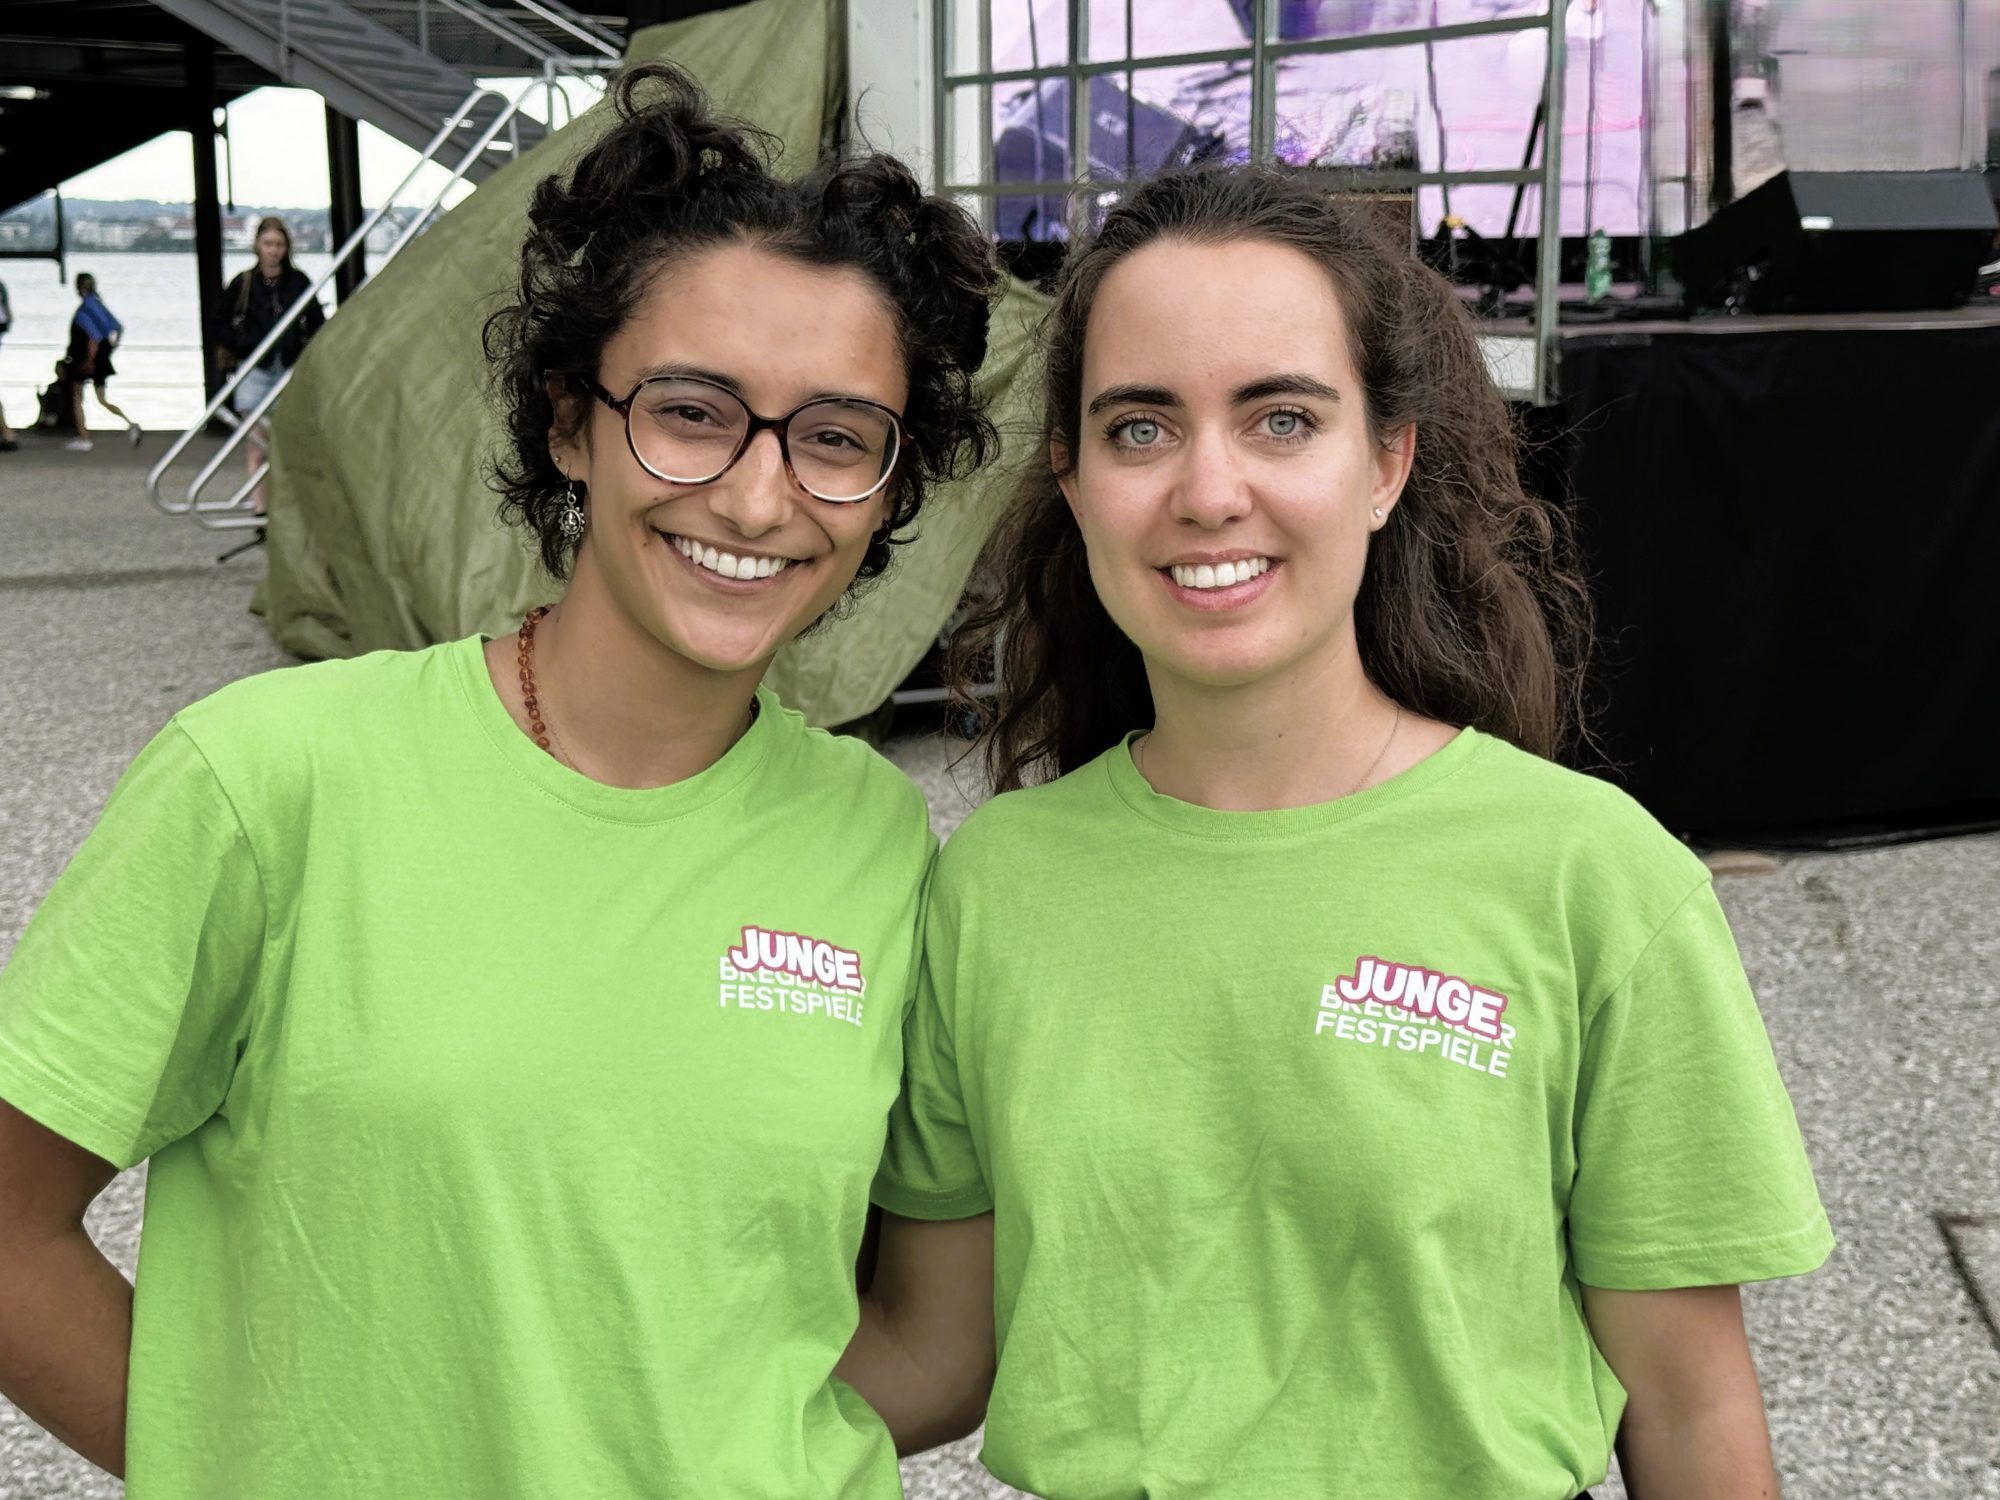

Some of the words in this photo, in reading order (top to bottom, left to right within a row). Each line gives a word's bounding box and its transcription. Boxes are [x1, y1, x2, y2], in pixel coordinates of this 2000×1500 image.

[729, 927, 861, 991] JUNGE
[719, 984, 864, 1027] FESTSPIELE
[1337, 958, 1505, 1037] JUNGE
[1315, 1011, 1511, 1078] FESTSPIELE
